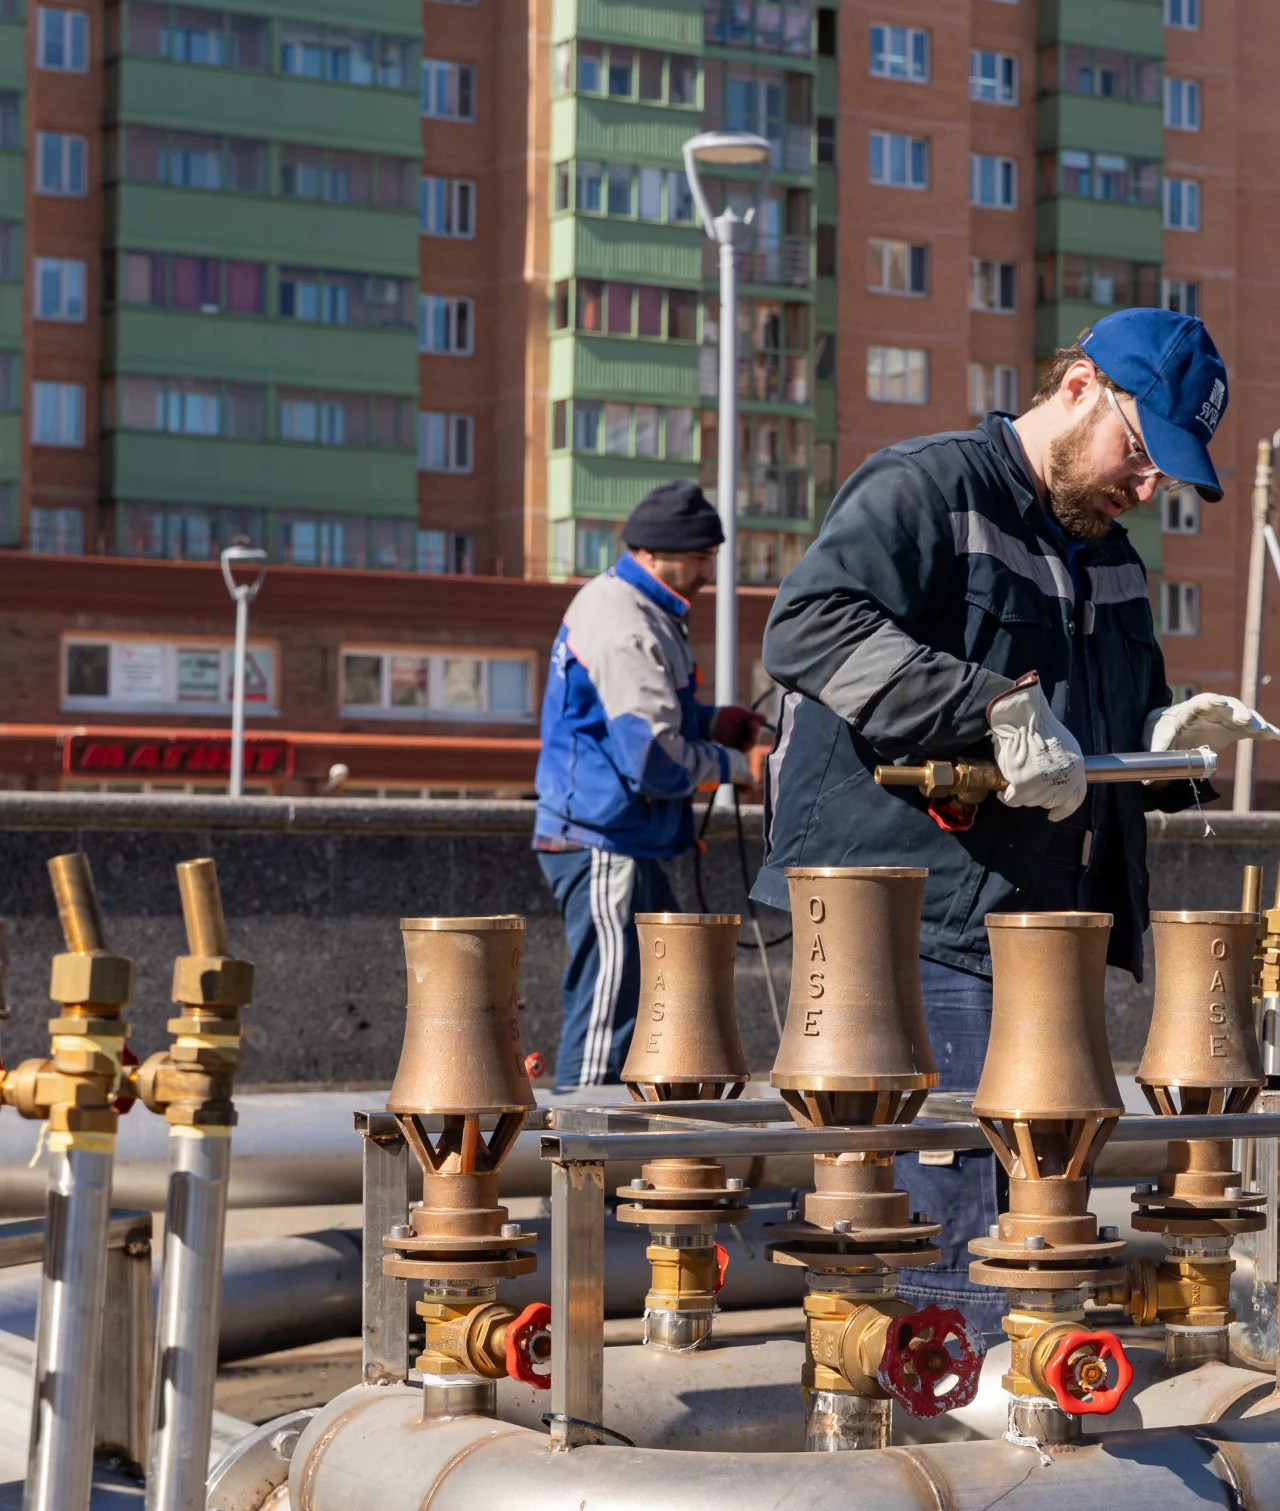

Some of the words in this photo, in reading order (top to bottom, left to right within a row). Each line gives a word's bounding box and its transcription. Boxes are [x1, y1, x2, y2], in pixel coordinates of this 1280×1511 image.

[80, 743, 282, 772] МАГНИТ
[646, 937, 666, 1054] OASE
[803, 895, 826, 1037] OASE
[1209, 938, 1227, 1057] OASE
